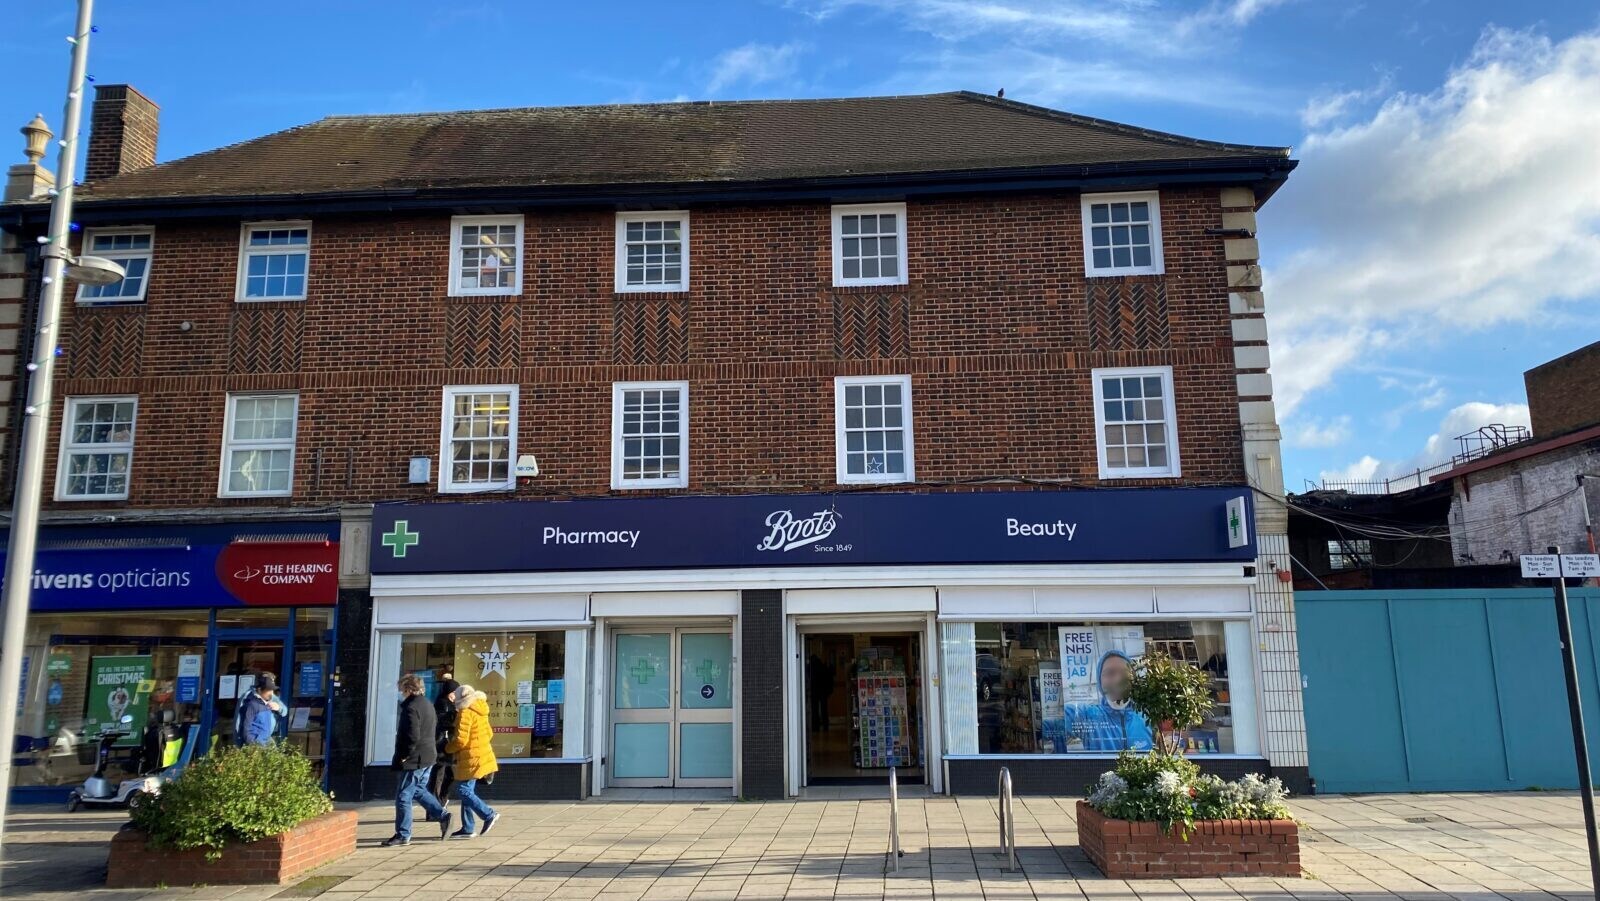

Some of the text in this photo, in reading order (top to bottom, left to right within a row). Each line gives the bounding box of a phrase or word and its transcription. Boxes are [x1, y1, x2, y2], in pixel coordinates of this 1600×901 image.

[757, 510, 836, 552] Boots
[1006, 518, 1077, 541] Beauty
[542, 526, 641, 548] Pharmacy
[814, 543, 853, 552] Since 1849
[263, 563, 333, 574] THE HEARING
[97, 568, 190, 593] opticians
[262, 574, 315, 585] COMPANY
[1065, 632, 1093, 643] FREE
[1066, 644, 1092, 655] NHS
[480, 651, 509, 660] STAR
[1066, 656, 1089, 666] FLU
[477, 661, 511, 670] GIFTS
[97, 672, 145, 685] CHRISTMAS
[1043, 672, 1062, 680] FREE
[1067, 668, 1087, 679] JAB
[1043, 679, 1061, 687] NHS
[1044, 687, 1059, 695] FLU
[511, 745, 525, 755] JOY
